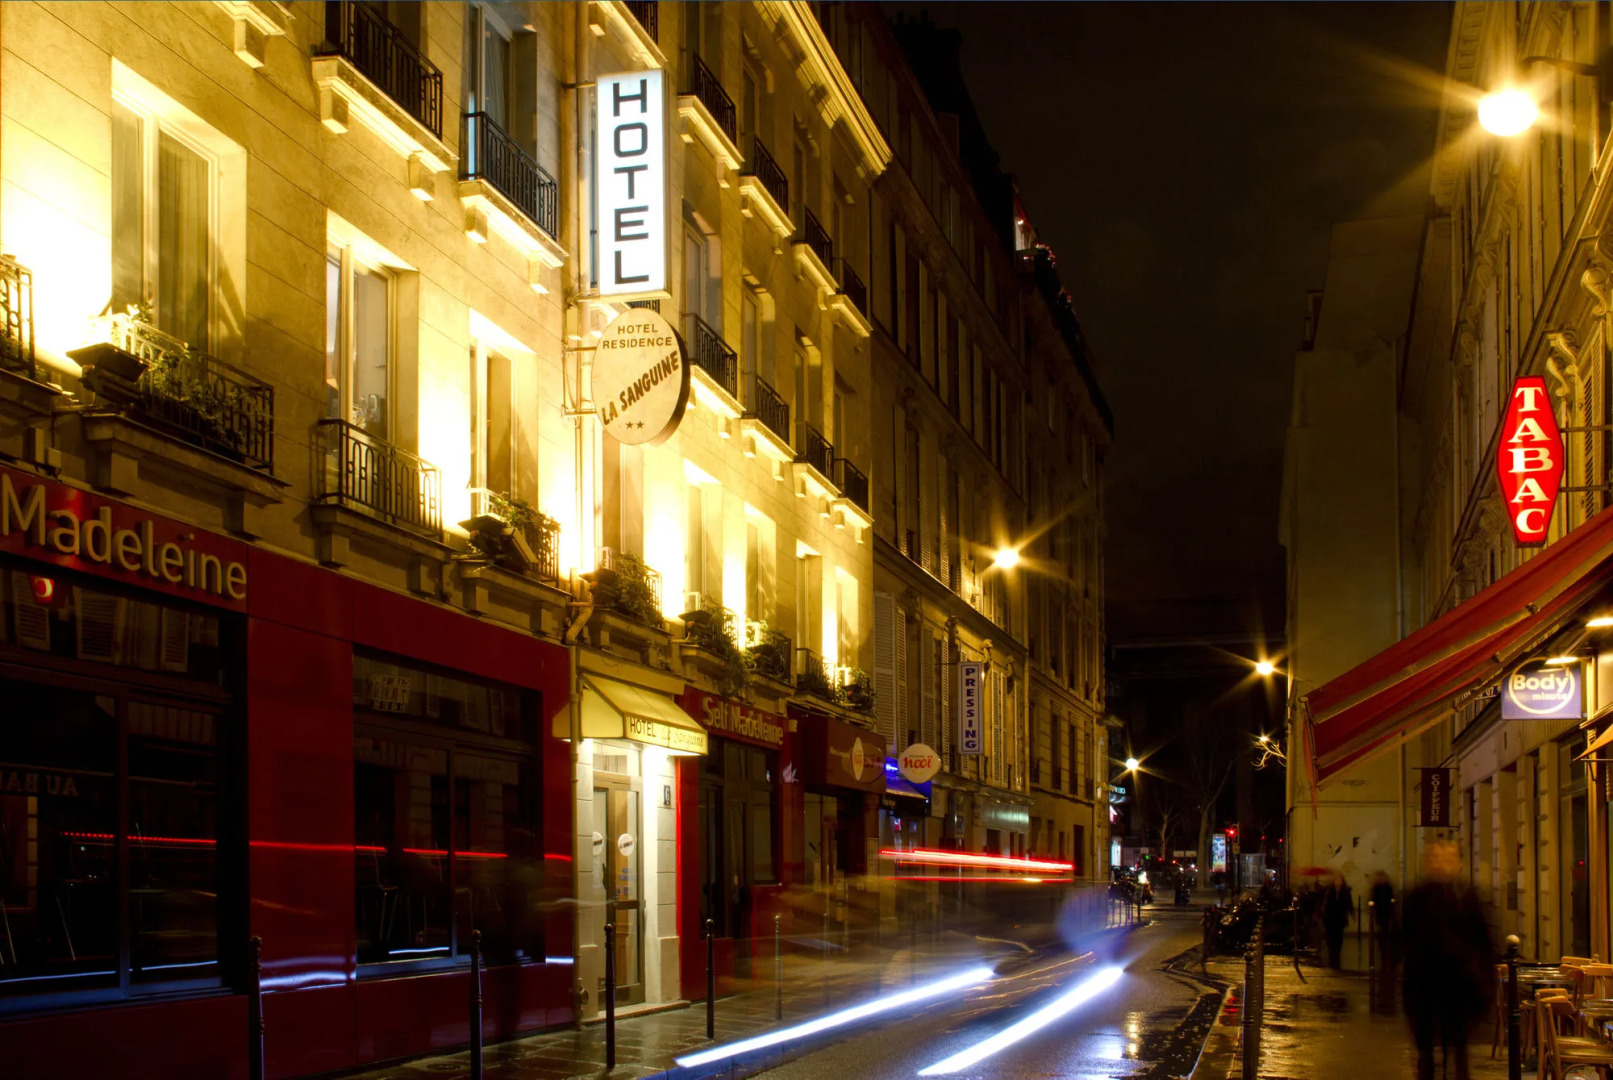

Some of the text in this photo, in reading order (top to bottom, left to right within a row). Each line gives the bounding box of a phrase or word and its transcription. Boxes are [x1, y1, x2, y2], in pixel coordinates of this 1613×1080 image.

[613, 79, 649, 284] HOTEL
[602, 337, 672, 349] RESIDENCE
[617, 324, 658, 334] HOTEL
[602, 350, 679, 425] LA SANGUINE
[1507, 386, 1554, 534] TABAC
[1, 473, 247, 599] Madeleine
[965, 667, 976, 749] PRESSING
[1513, 673, 1569, 693] Body
[629, 716, 656, 738] HOTEL
[702, 696, 728, 731] Self
